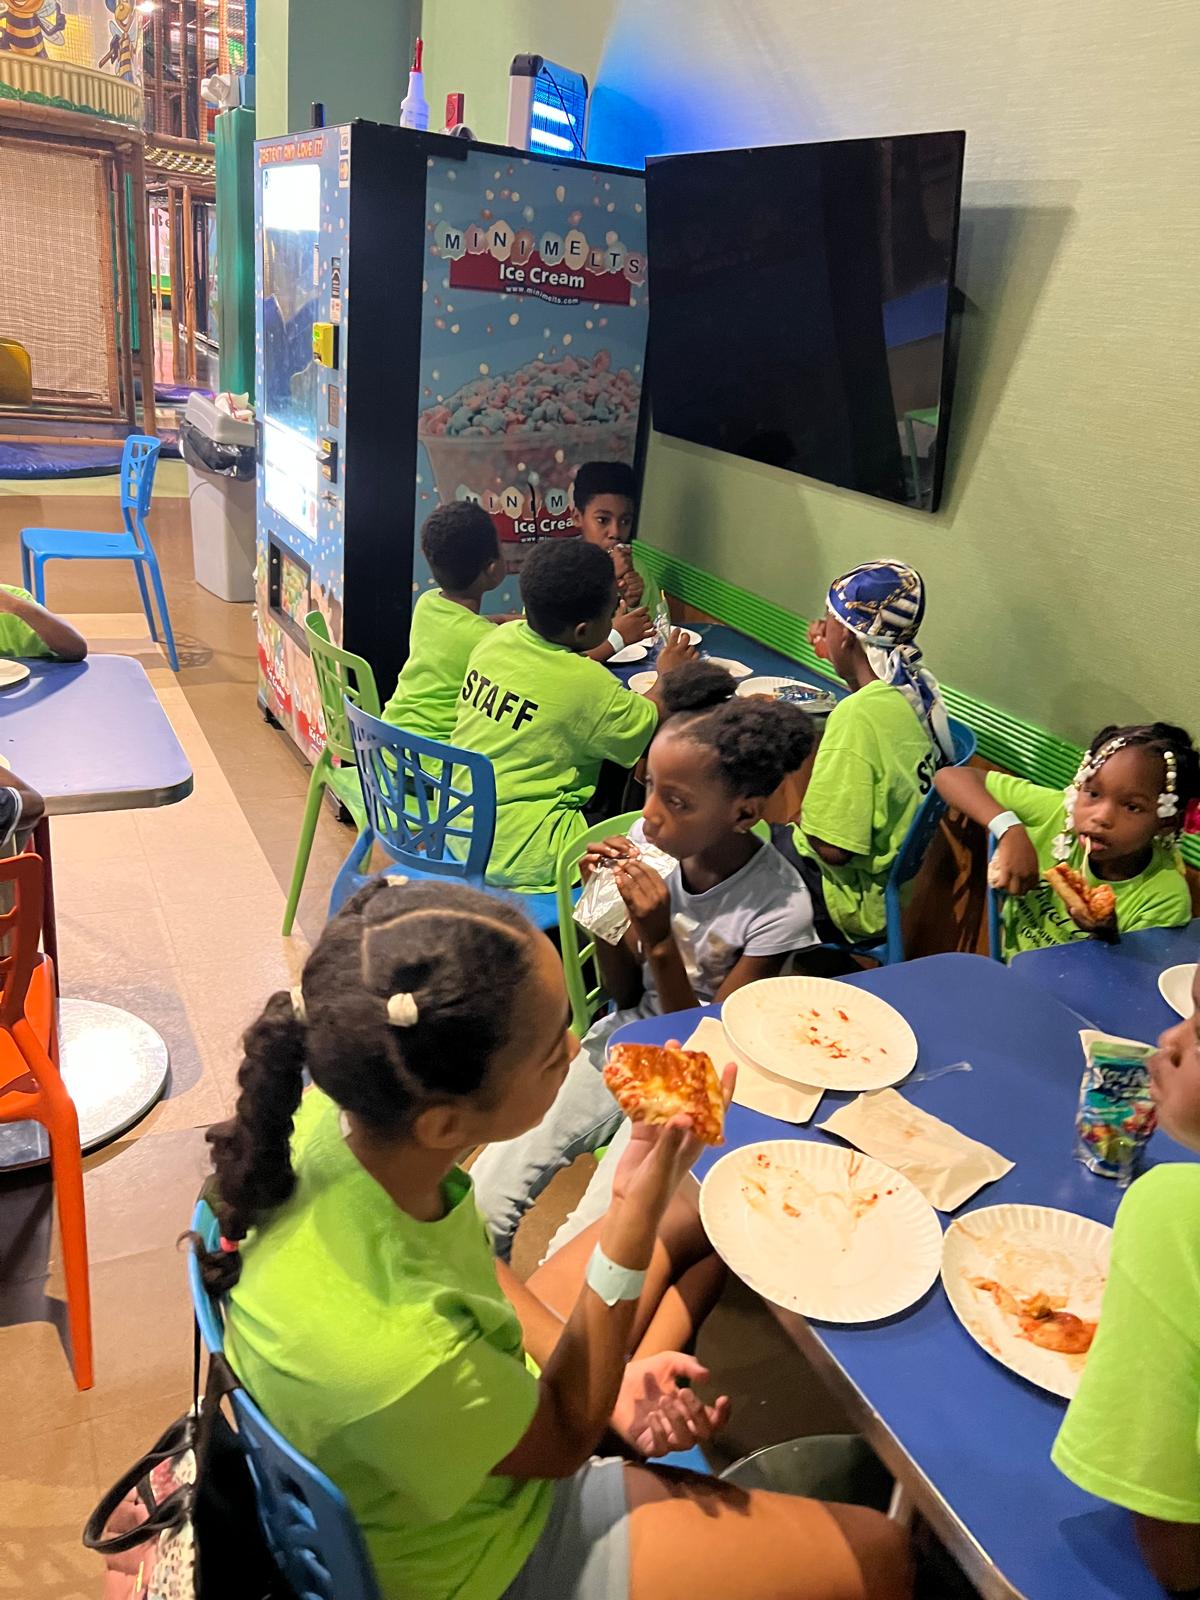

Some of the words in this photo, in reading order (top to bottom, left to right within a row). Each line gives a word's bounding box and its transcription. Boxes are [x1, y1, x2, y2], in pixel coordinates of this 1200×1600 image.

[545, 240, 639, 274] MELTS
[500, 264, 525, 282] Ice
[529, 267, 585, 288] Cream
[505, 286, 579, 305] www.minimelts.com
[514, 520, 536, 533] Ice
[540, 517, 576, 532] Crea
[462, 669, 539, 731] STAFF
